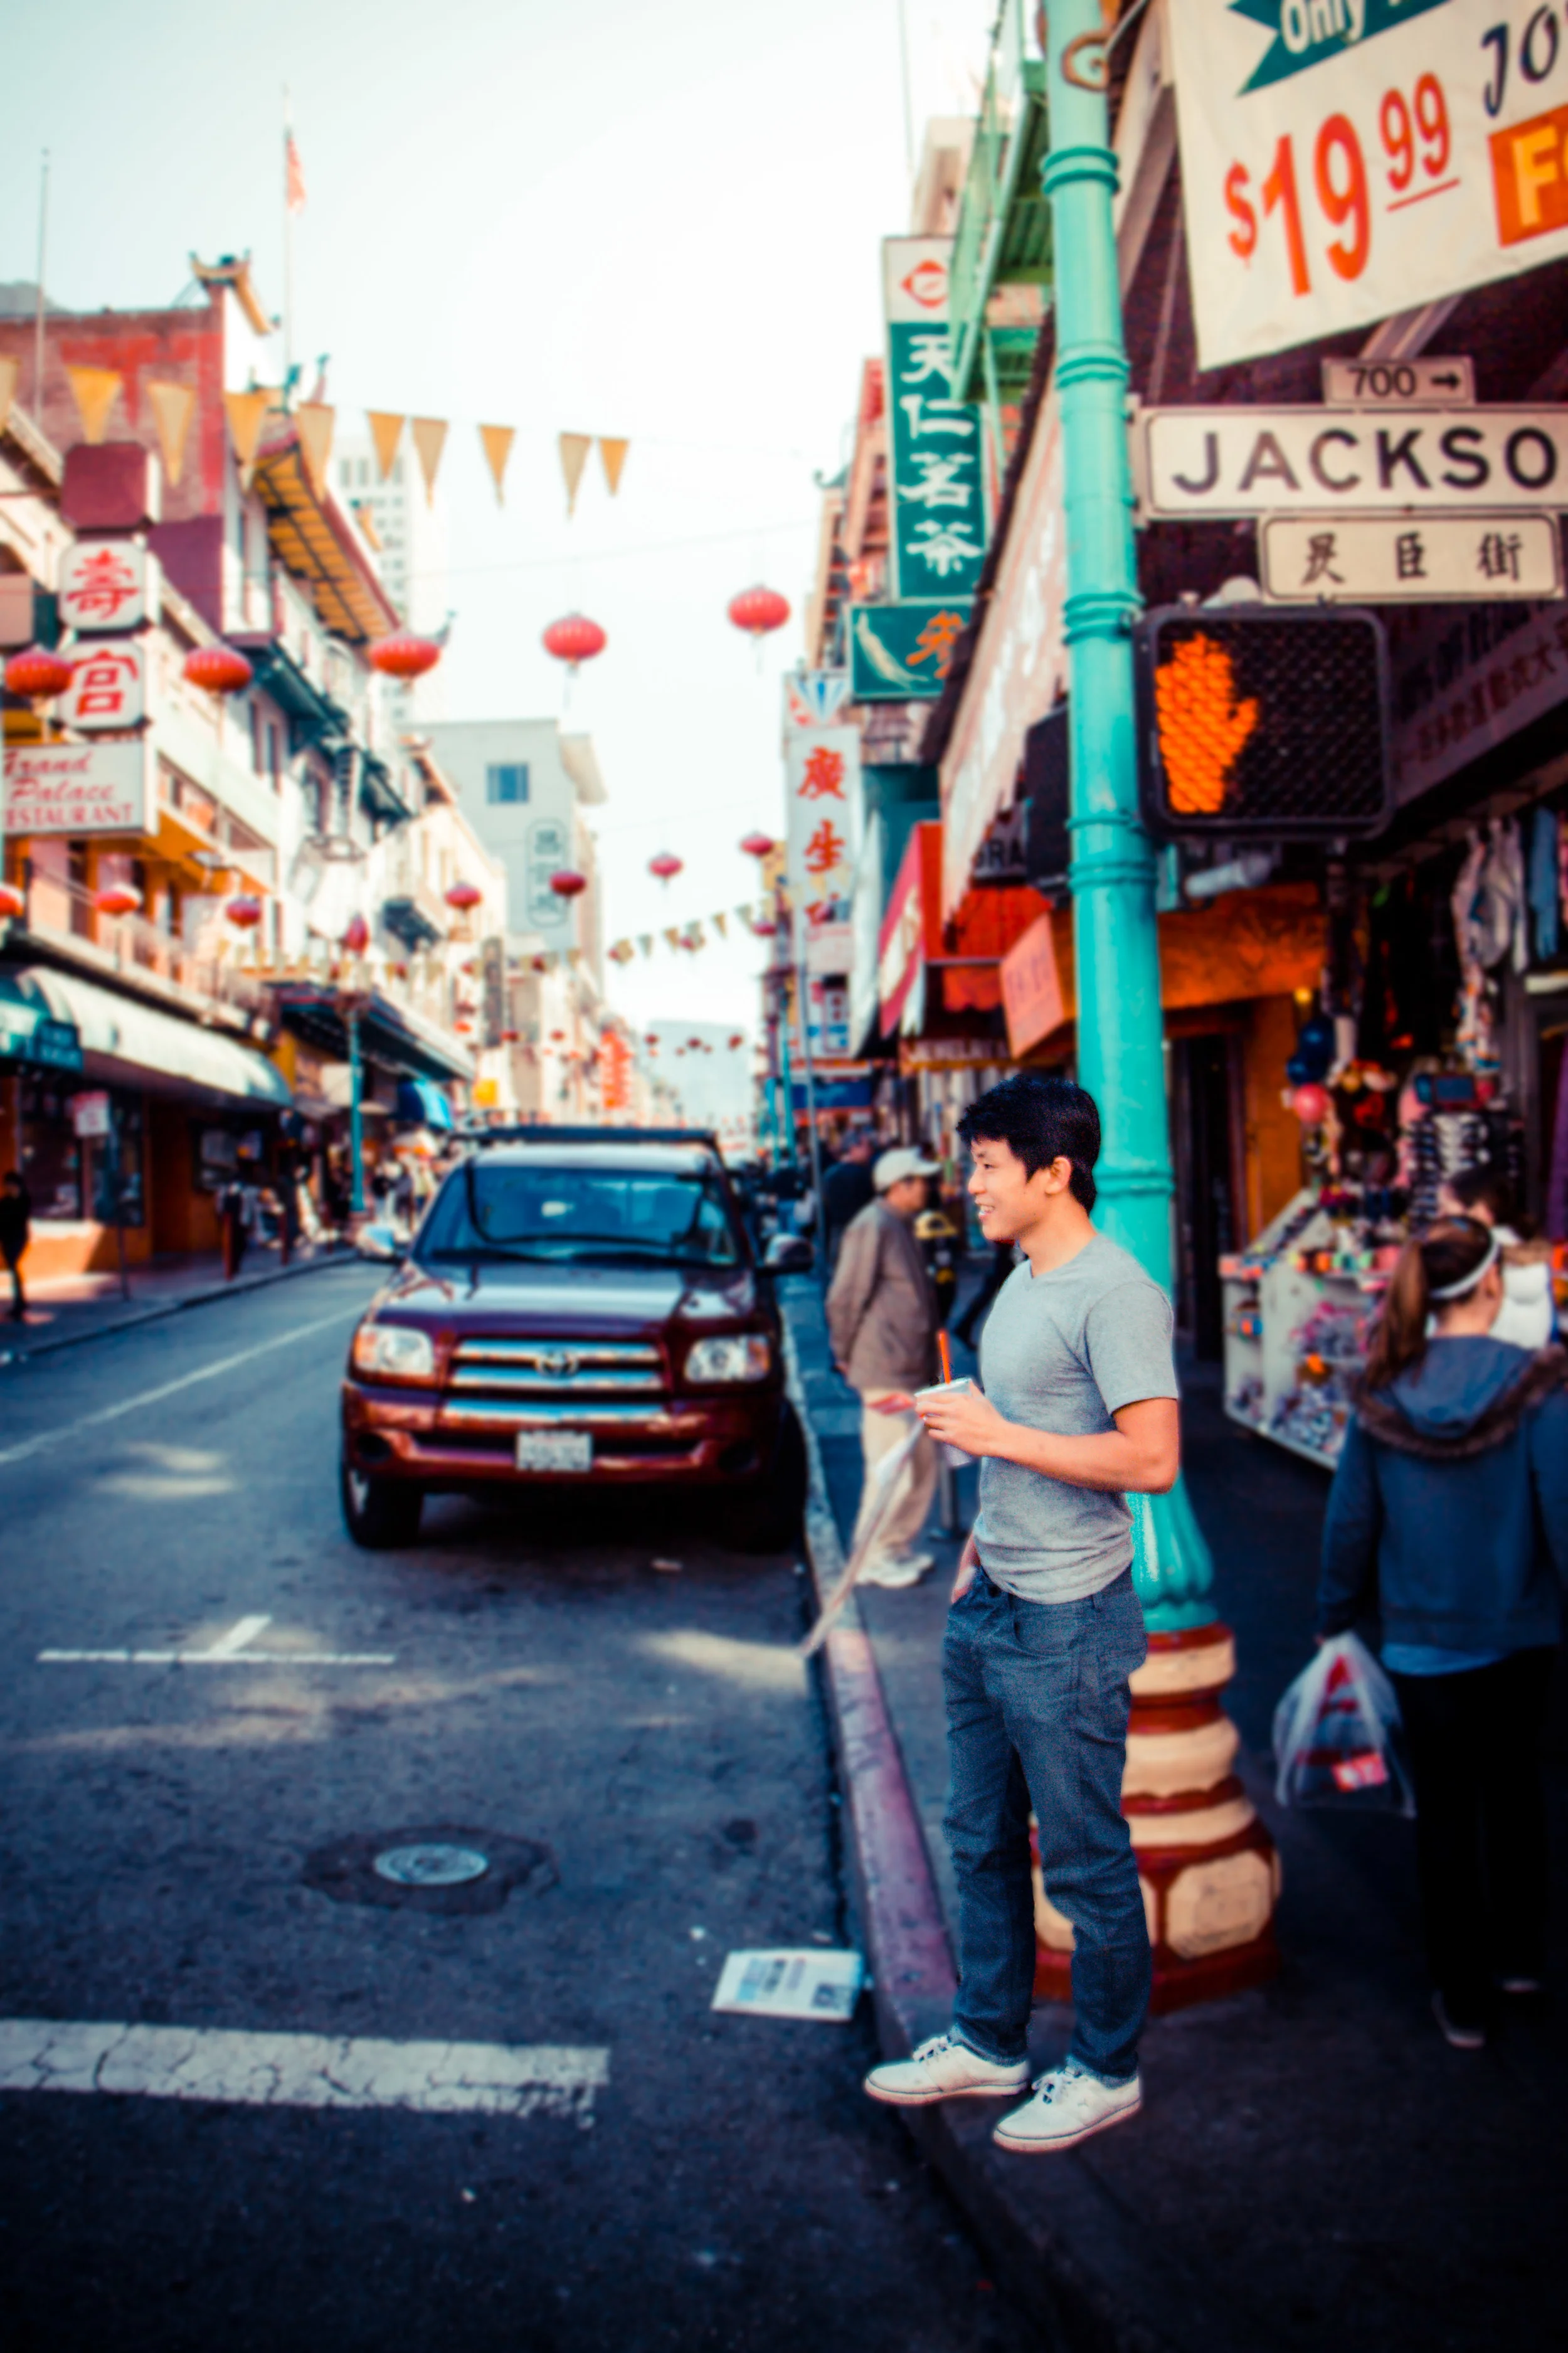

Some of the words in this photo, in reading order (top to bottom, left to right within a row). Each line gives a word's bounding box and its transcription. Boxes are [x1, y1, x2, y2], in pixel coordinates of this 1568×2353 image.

[1480, 4, 1568, 119] JO
[1512, 124, 1568, 227] F
[1347, 366, 1416, 398] 700
[1171, 425, 1558, 494] JACKSO
[11, 777, 114, 802] Palace
[6, 803, 133, 829] ESTAURANT
